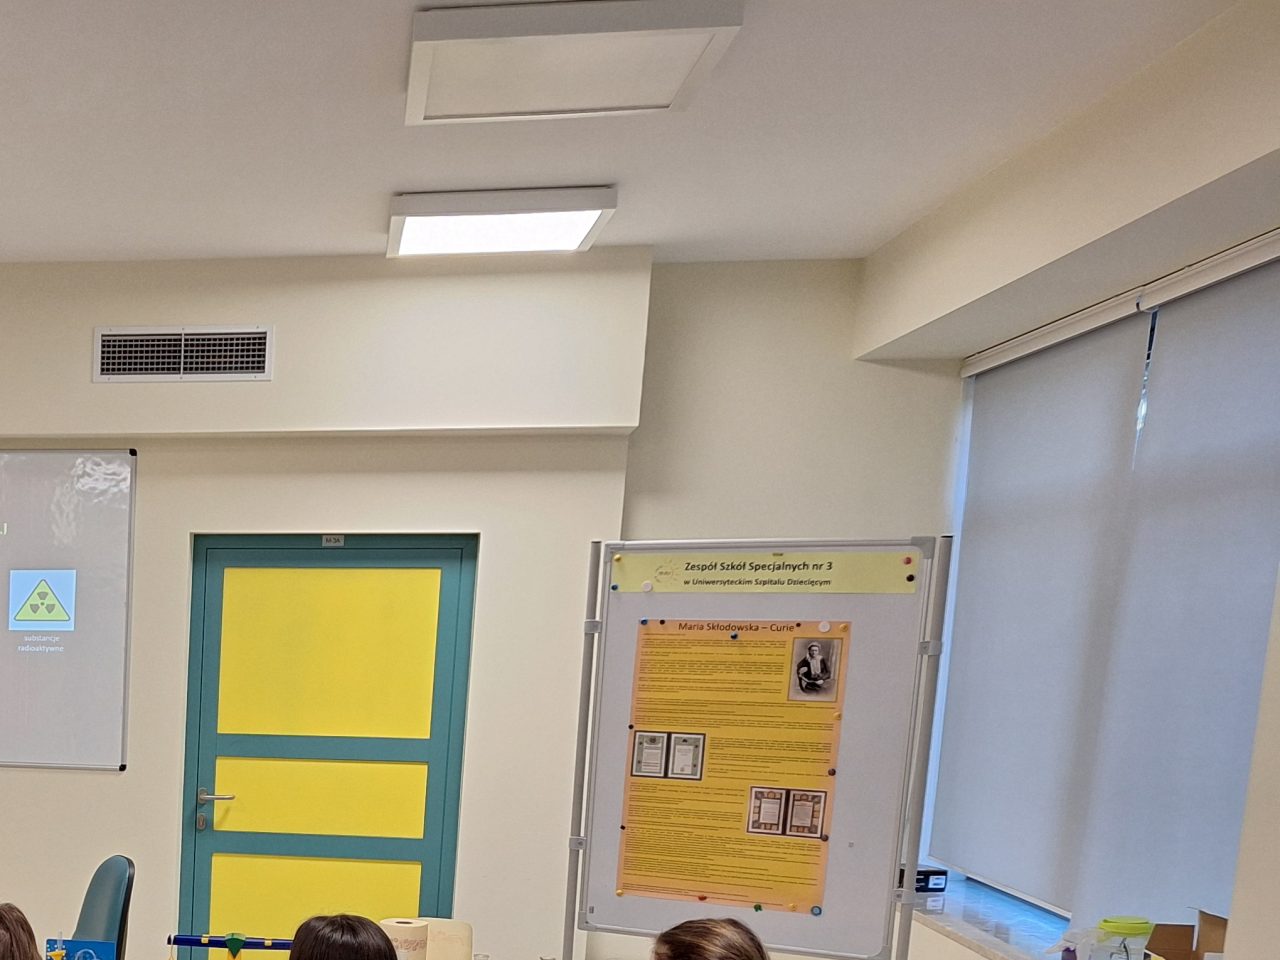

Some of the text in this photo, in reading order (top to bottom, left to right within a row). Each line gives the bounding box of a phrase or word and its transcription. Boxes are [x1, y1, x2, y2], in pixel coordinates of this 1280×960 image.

[684, 561, 833, 572] Zespół Szkół Specjalnych nr 3
[692, 578, 753, 586] Uniwersyteckim
[754, 578, 785, 586] Szpitalu
[787, 578, 831, 587] Dziecięcym
[678, 622, 705, 631] Maria
[706, 622, 760, 632] Skłodowska
[769, 623, 795, 632] Curie
